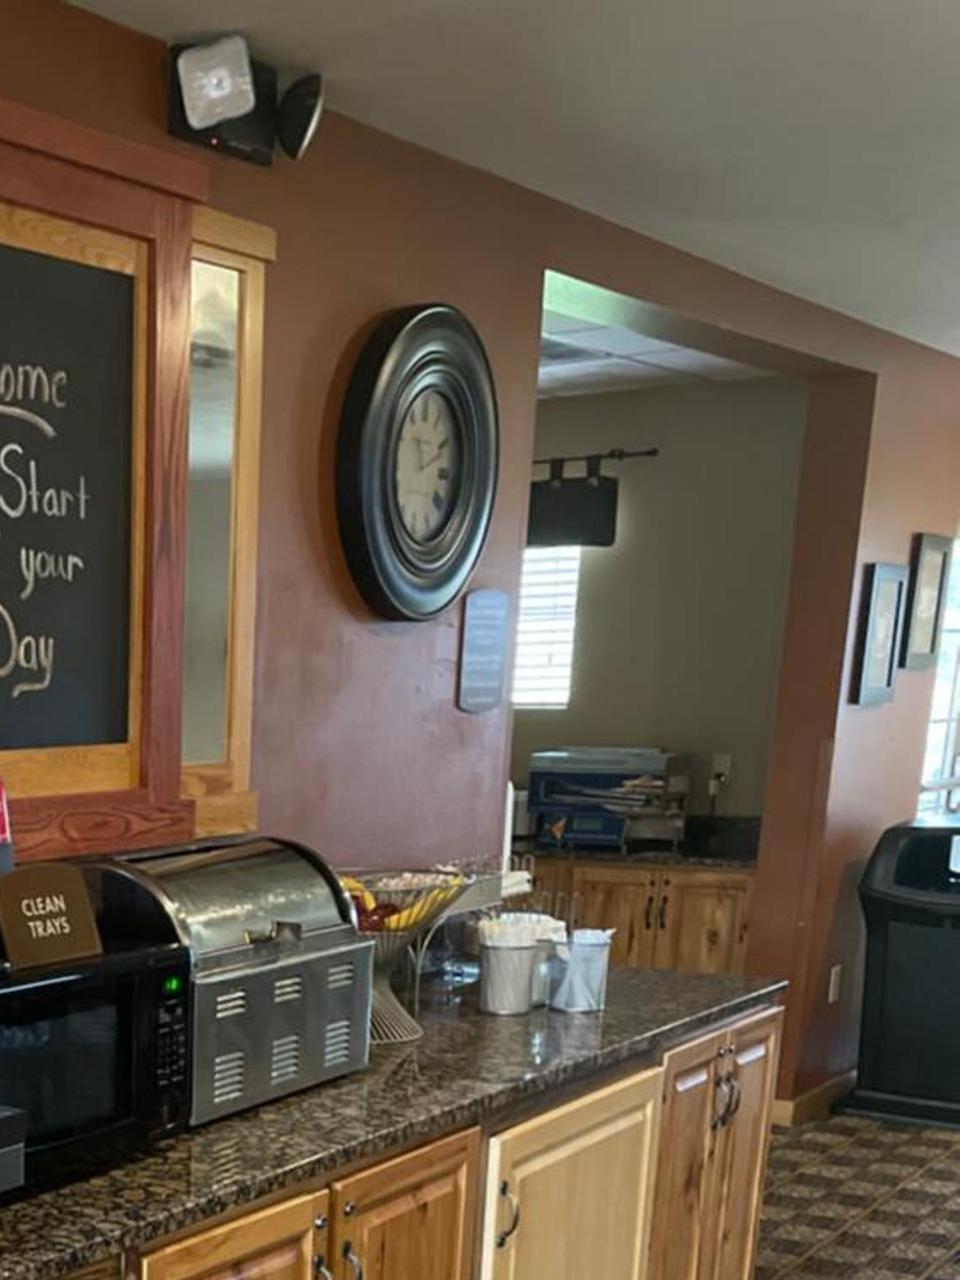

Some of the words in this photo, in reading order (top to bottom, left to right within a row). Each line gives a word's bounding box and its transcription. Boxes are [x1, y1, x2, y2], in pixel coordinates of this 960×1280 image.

[20, 546, 84, 600] your
[21, 894, 66, 917] CLEAN
[27, 916, 71, 939] TRAYS
